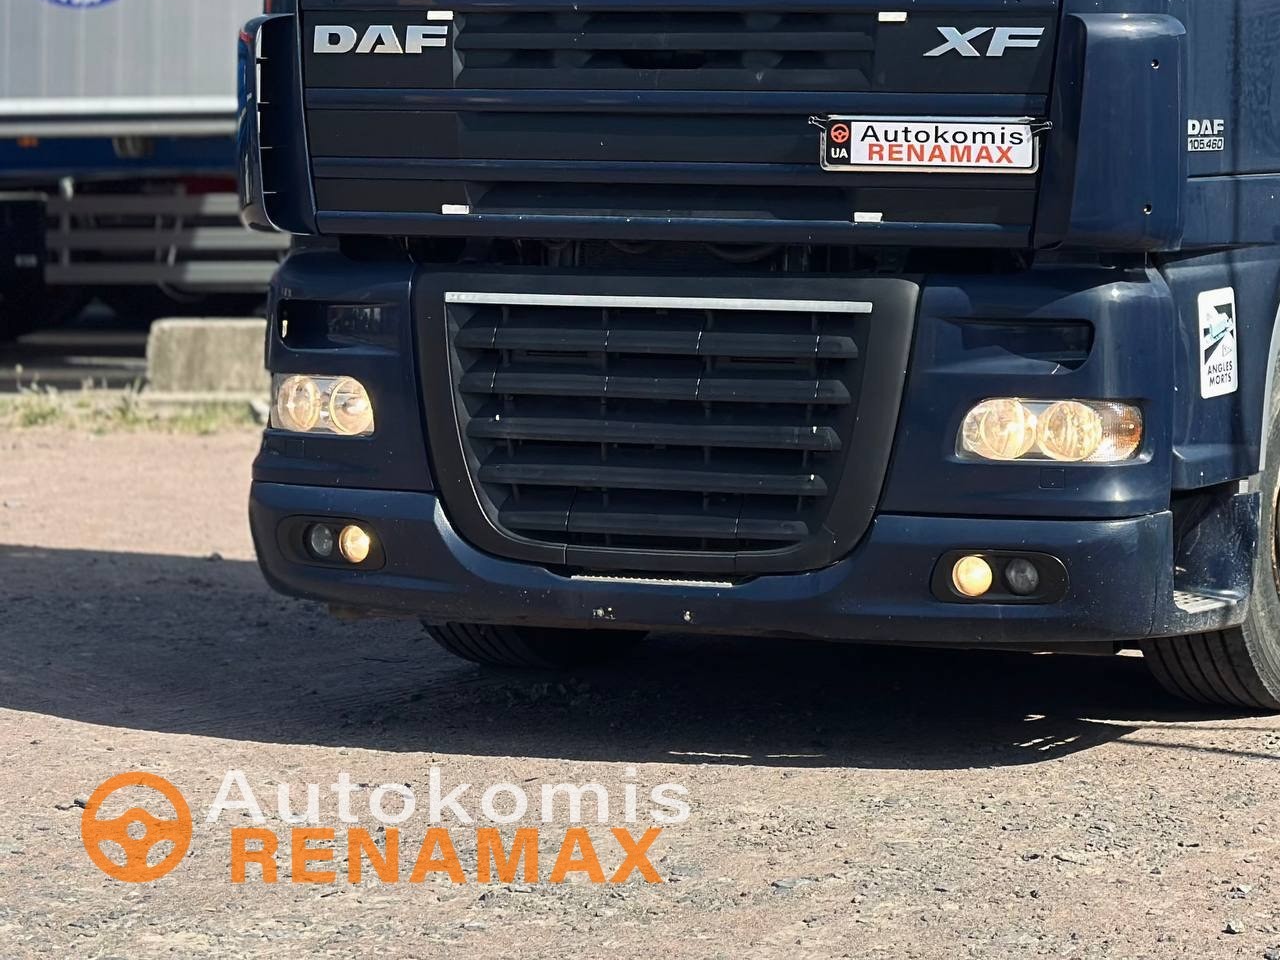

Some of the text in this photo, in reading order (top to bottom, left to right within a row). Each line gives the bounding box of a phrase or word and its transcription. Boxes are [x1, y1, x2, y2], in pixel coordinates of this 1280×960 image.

[313, 24, 449, 54] DAF
[922, 26, 1045, 57] XF
[860, 125, 1024, 145] Autokomis
[1187, 119, 1225, 135] DAF
[831, 148, 848, 159] UA
[867, 143, 1014, 164] RENAMAX
[1207, 360, 1233, 375] ANGLES
[1209, 373, 1232, 387] MORTS
